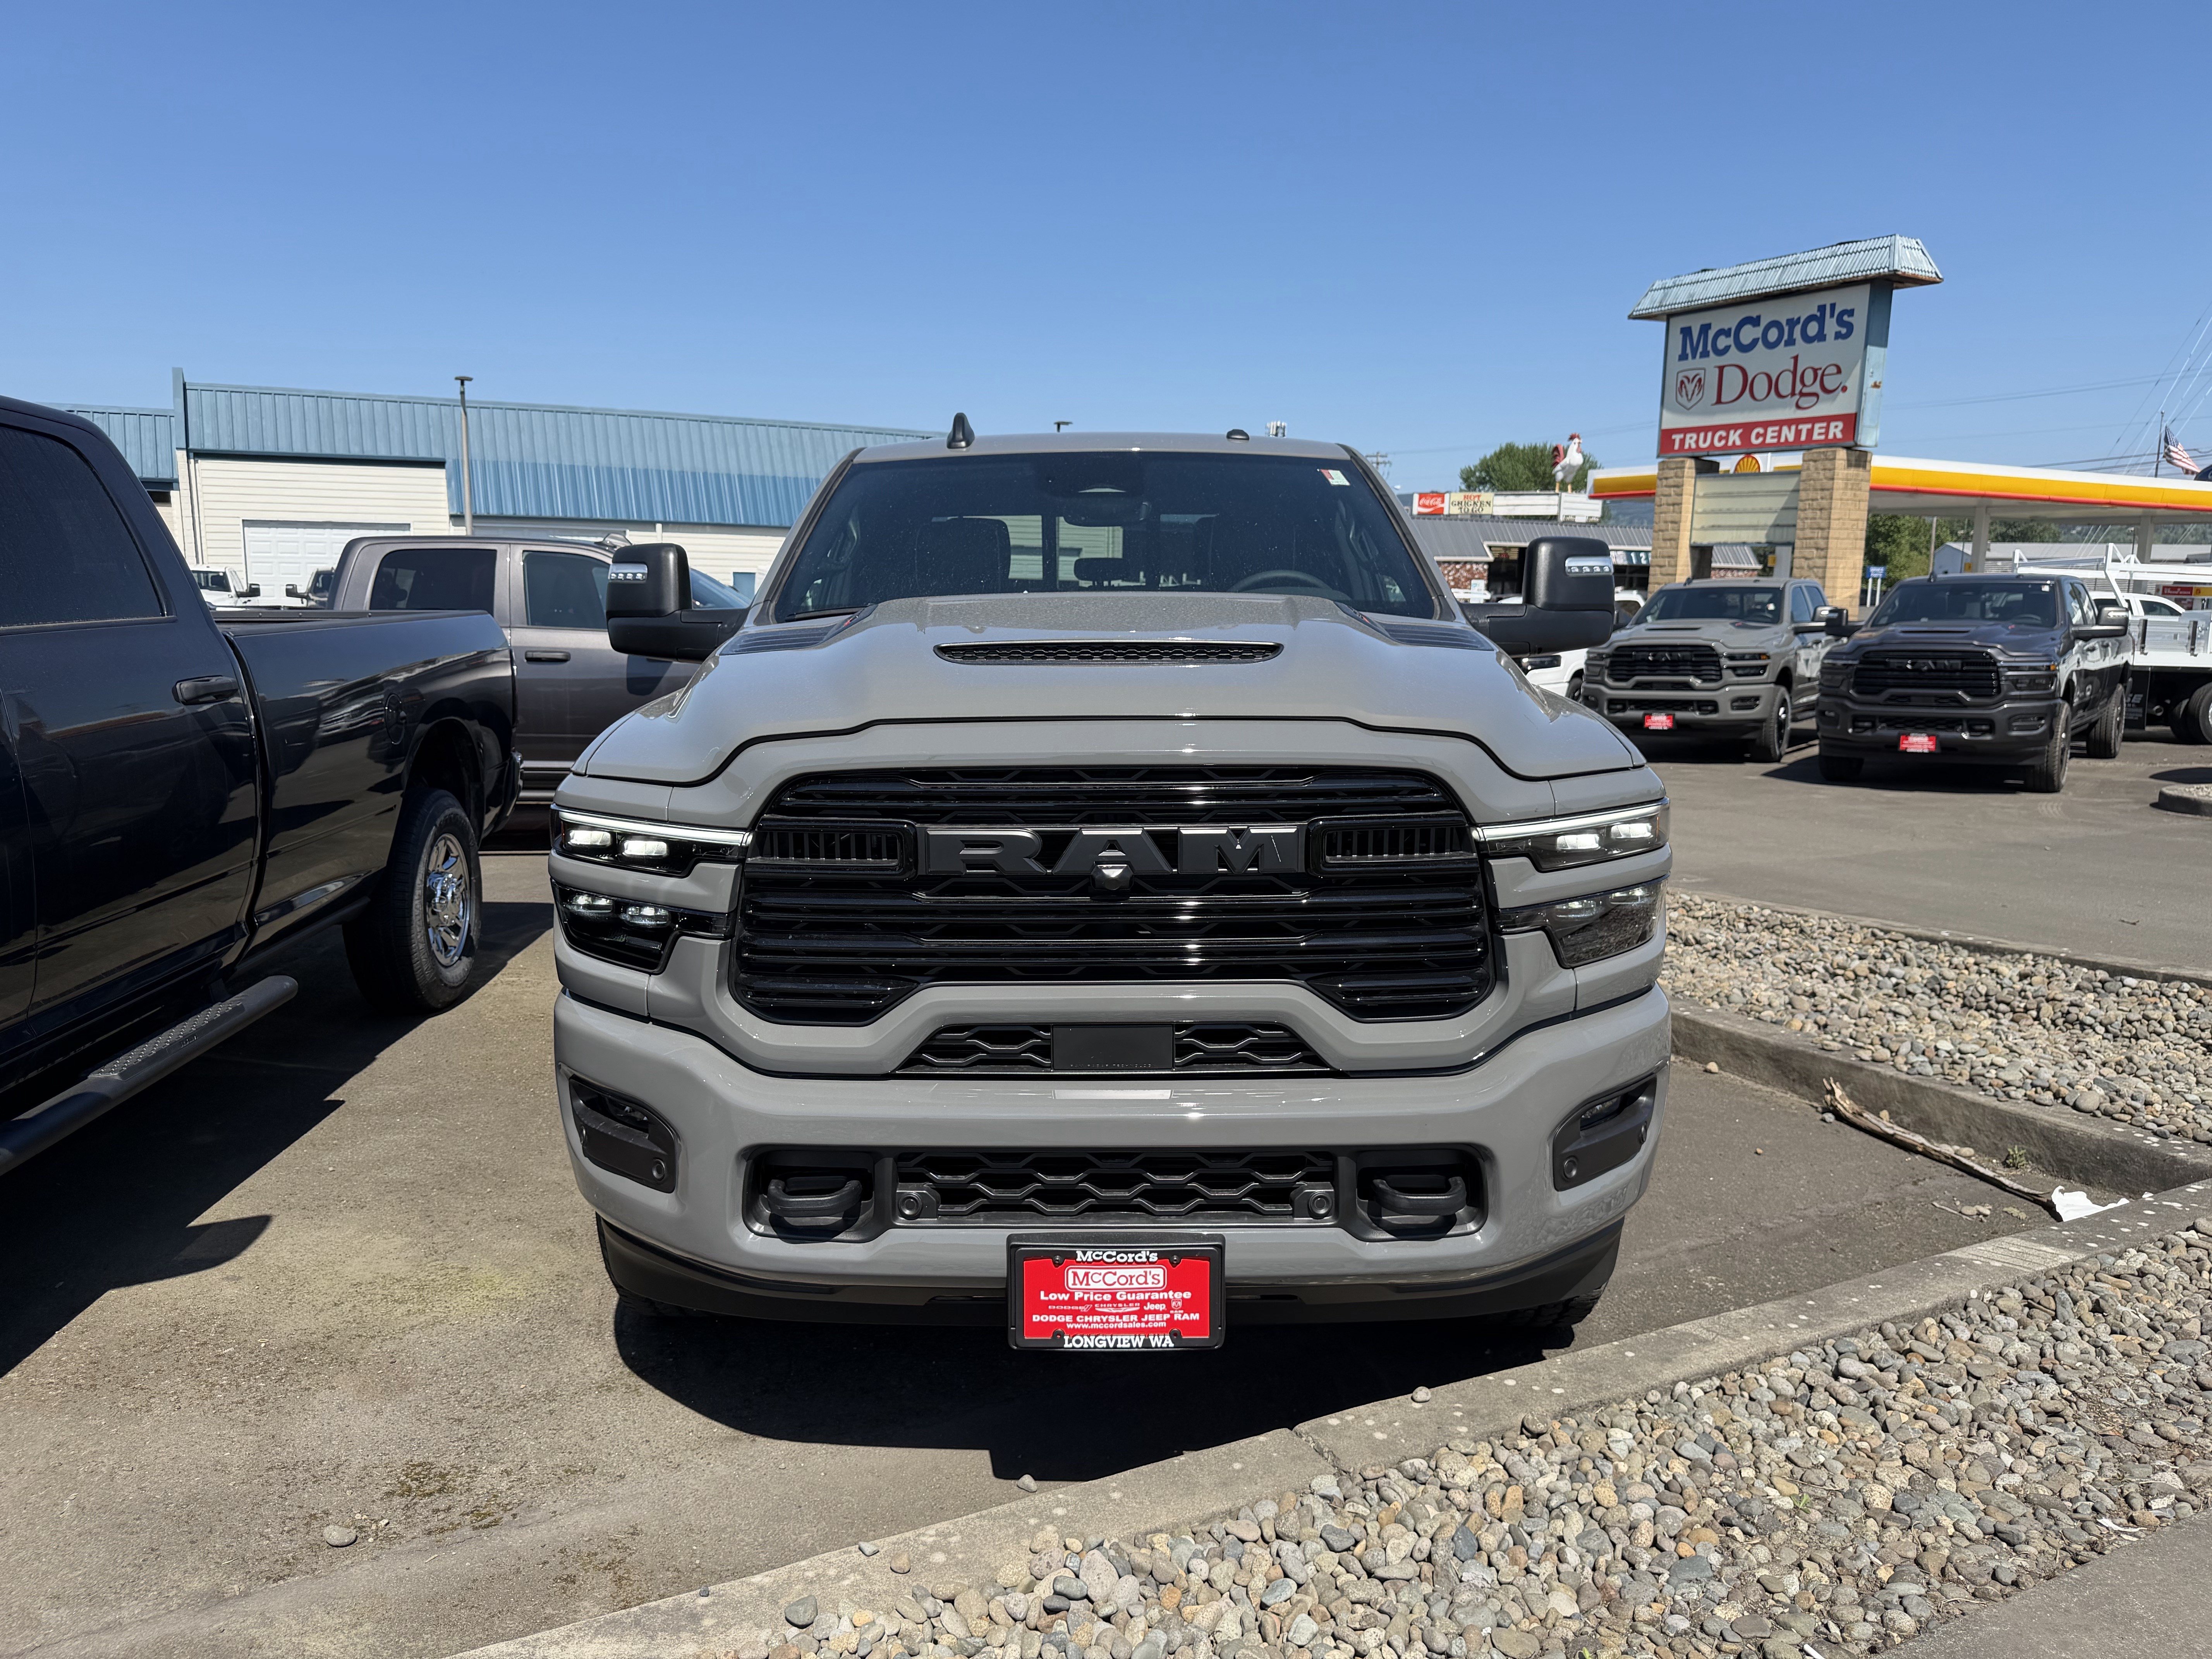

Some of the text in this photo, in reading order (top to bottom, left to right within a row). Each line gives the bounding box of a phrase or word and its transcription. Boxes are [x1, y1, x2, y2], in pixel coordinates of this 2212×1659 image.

[1678, 302, 1855, 361] McCord's
[1671, 421, 1843, 450] TRUCK CENTER
[926, 827, 1299, 875] RAM
[1076, 1250, 1158, 1263] McCord's
[1072, 1271, 1160, 1286] McCord's
[1040, 1290, 1192, 1301] Low Price Guarantee
[1144, 1302, 1166, 1311] Jeep
[1064, 1336, 1174, 1348] LONGVIEW WA
